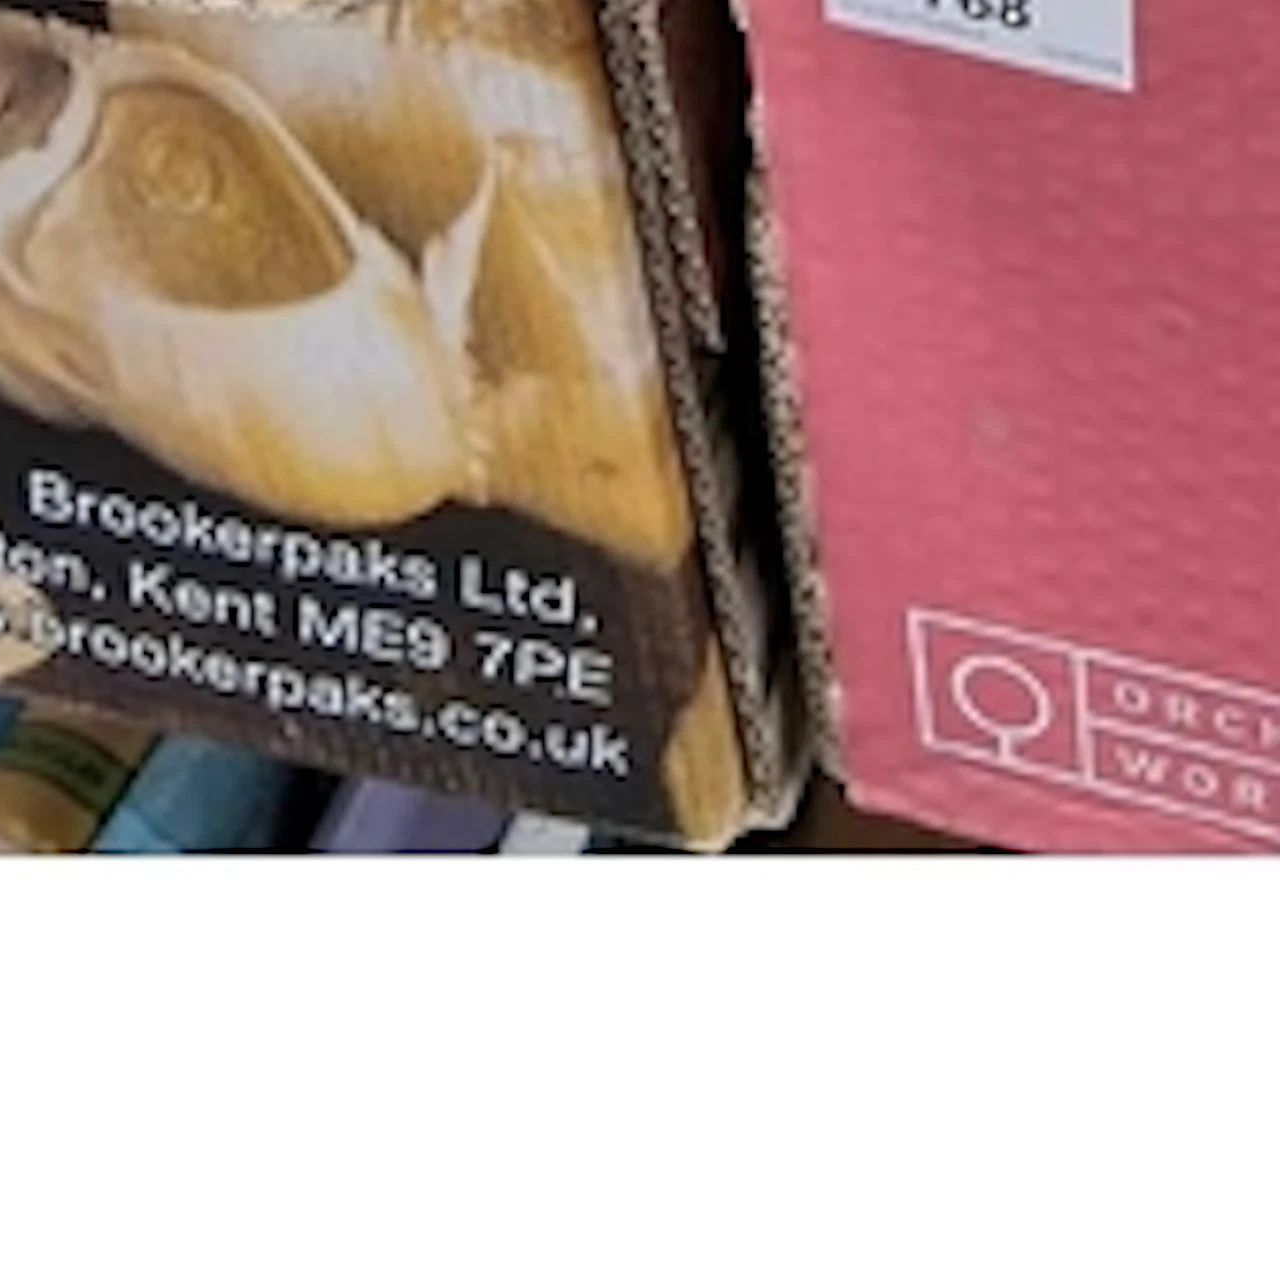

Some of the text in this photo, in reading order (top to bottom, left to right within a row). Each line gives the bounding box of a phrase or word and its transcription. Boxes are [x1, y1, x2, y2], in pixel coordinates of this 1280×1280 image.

[28, 468, 439, 599] Brookerpaks
[128, 560, 279, 637] Kent
[297, 595, 452, 670] ME9
[473, 628, 614, 708] 7PE
